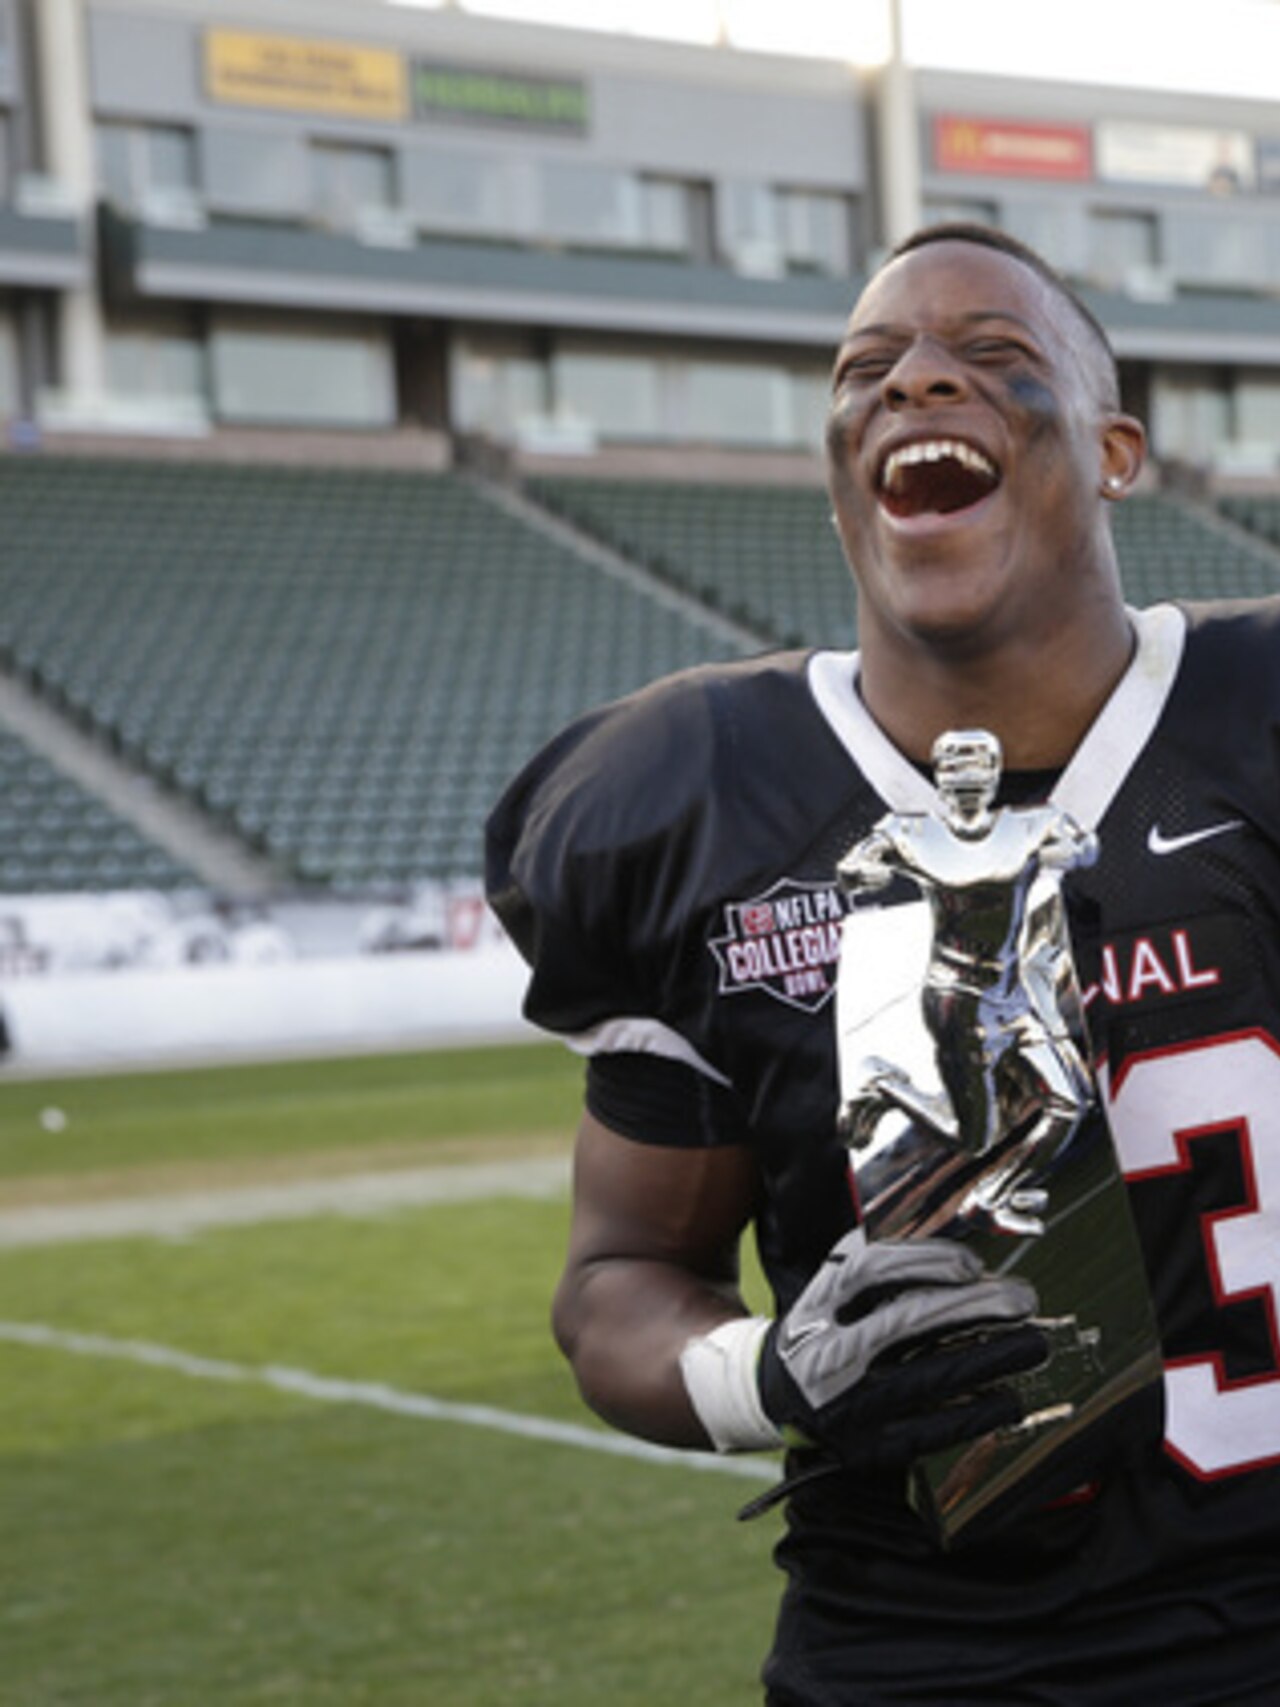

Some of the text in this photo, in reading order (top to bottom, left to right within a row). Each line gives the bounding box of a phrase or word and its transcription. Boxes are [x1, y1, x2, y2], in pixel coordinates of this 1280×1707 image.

[775, 888, 842, 930] NFLPA
[726, 920, 845, 982] COLLEGIA
[1081, 928, 1222, 1006] NAL
